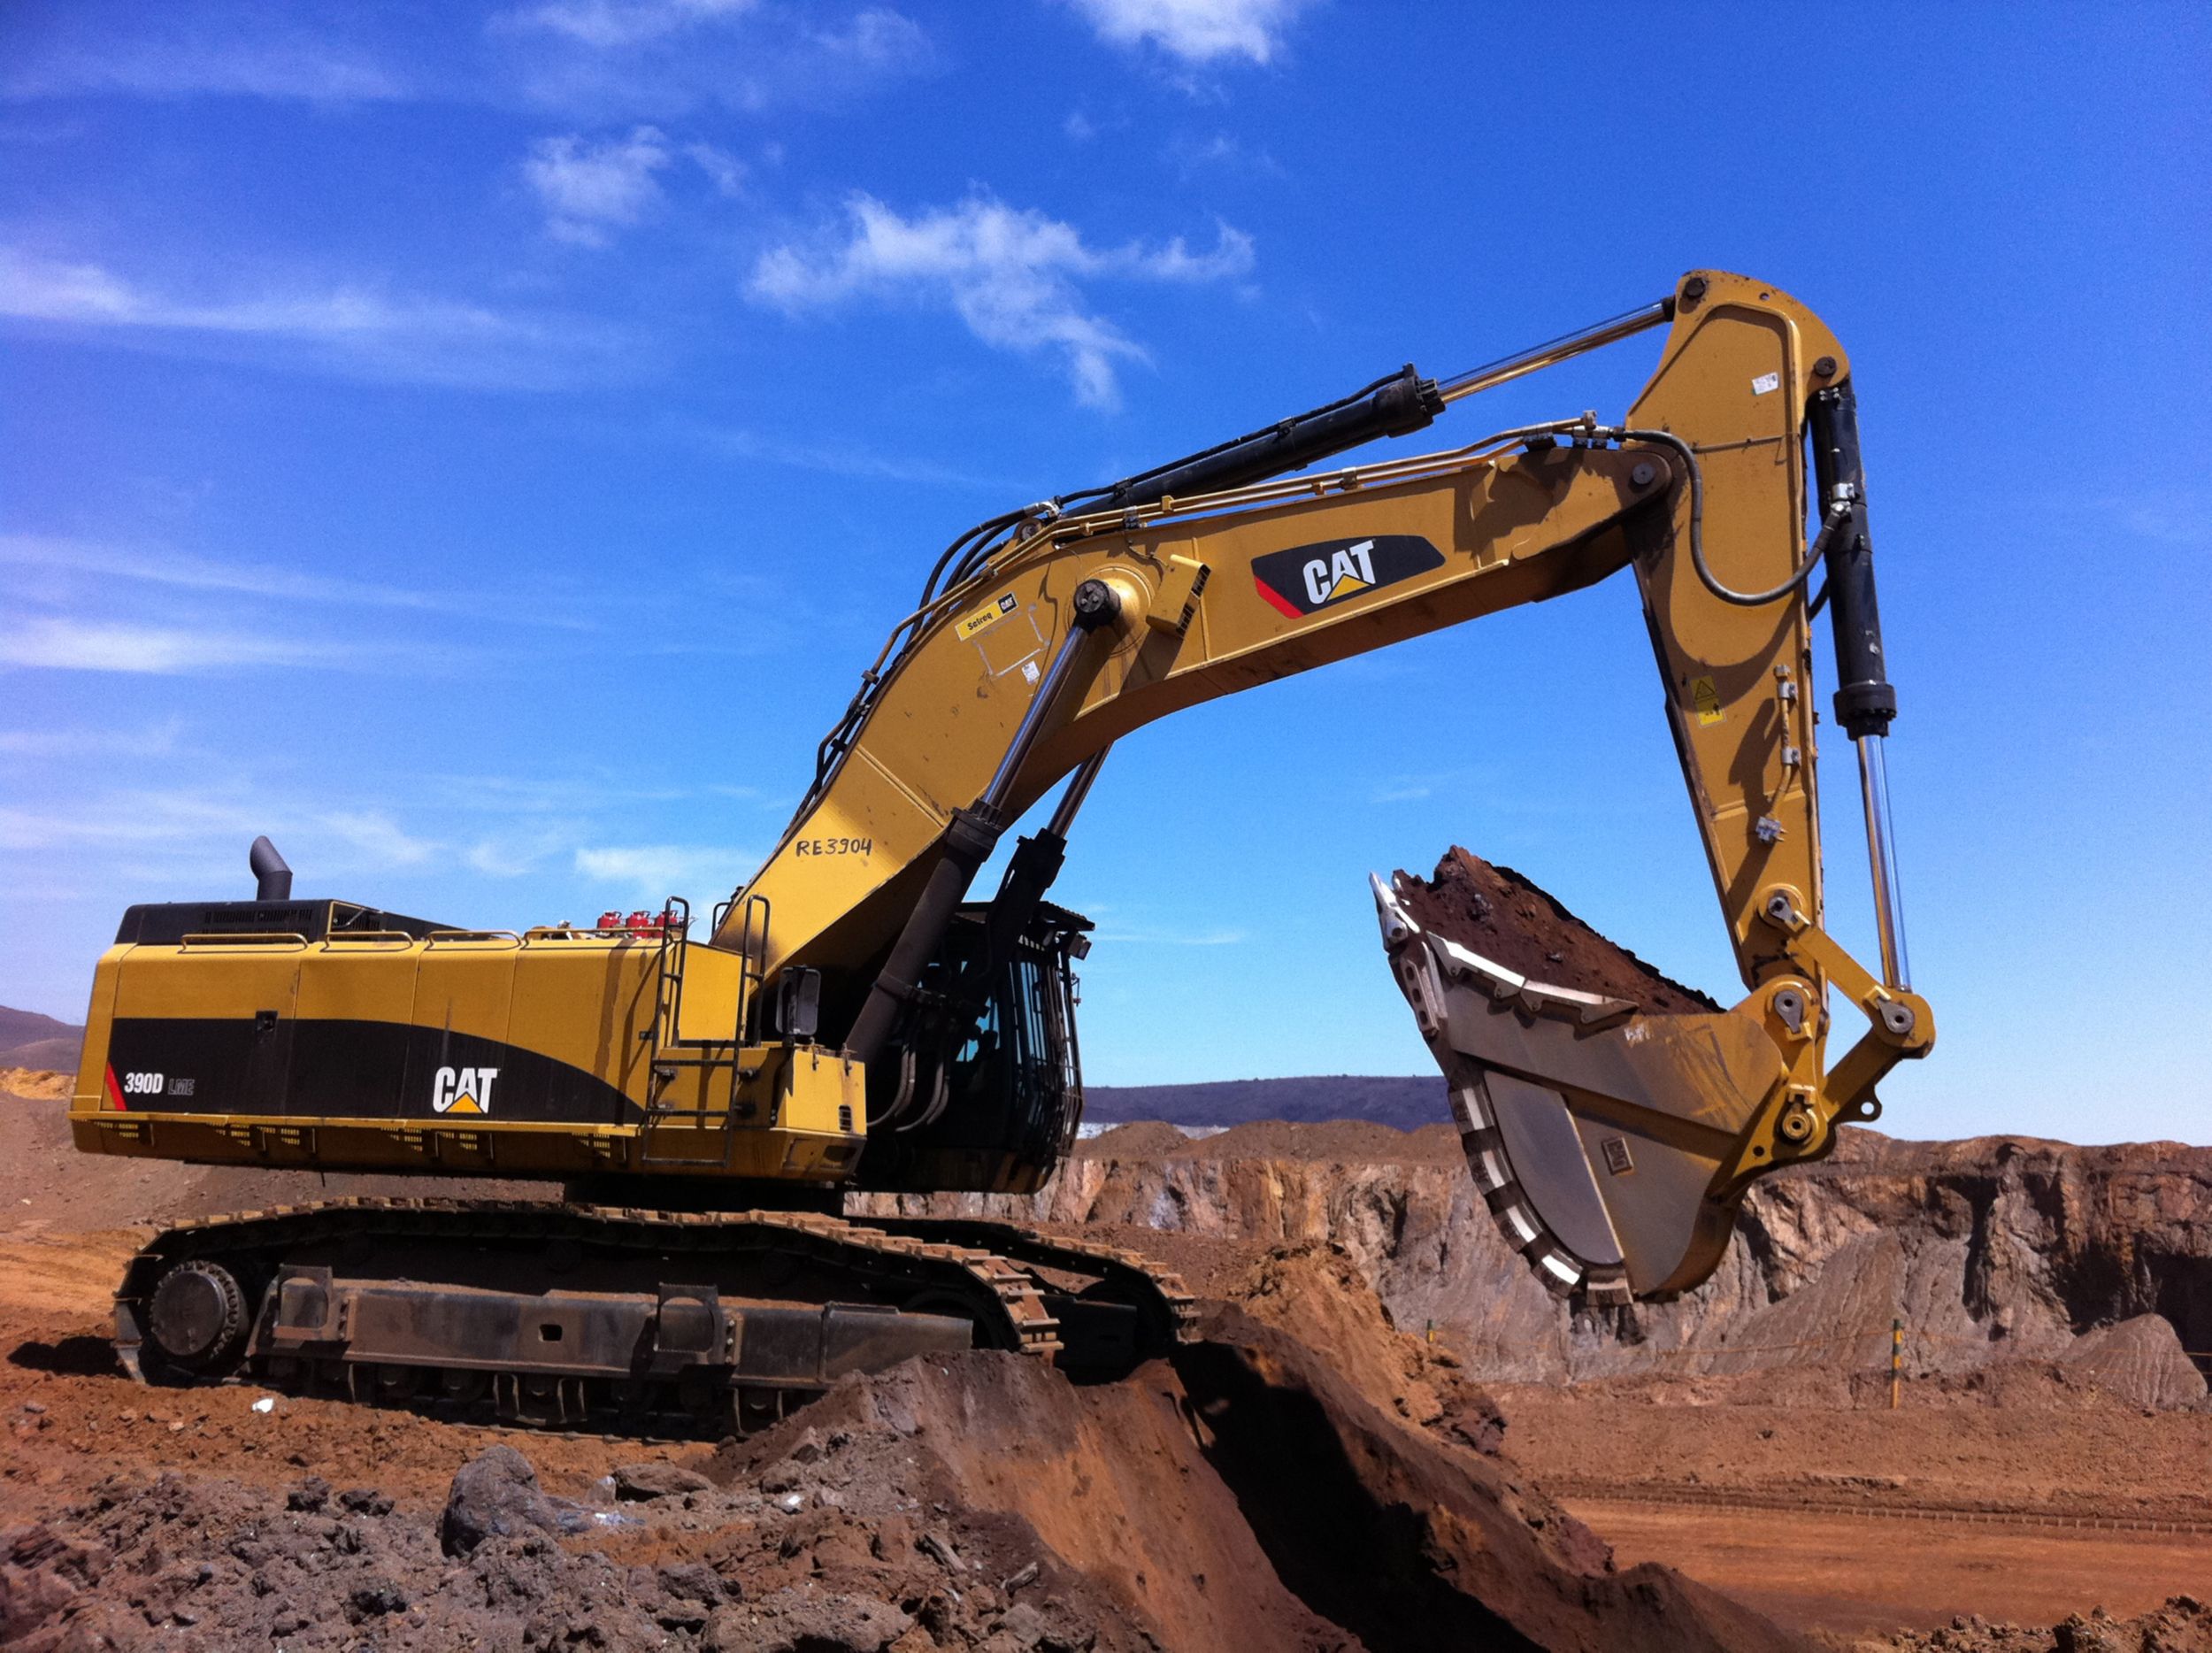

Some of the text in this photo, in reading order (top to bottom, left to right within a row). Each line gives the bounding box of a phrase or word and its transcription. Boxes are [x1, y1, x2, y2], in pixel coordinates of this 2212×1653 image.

[1302, 540, 1376, 604] CAT
[796, 838, 872, 857] RE3904
[124, 1072, 164, 1094] 390D
[433, 1066, 498, 1113] CAT
